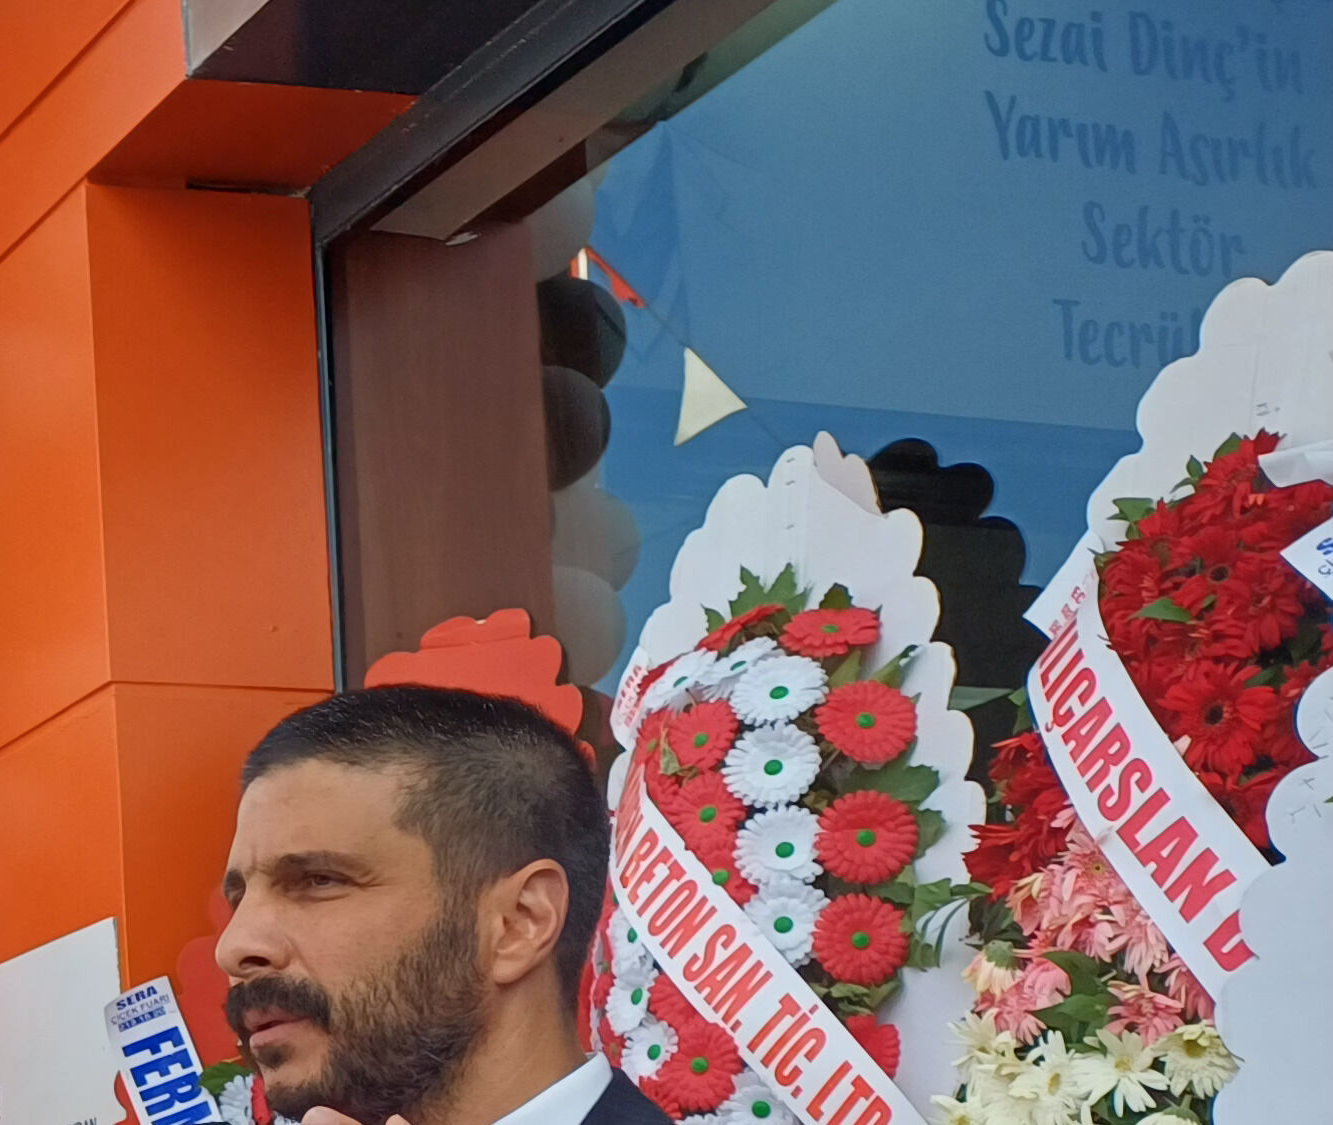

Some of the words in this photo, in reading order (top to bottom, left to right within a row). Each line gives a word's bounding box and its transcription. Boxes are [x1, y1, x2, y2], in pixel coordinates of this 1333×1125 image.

[984, 0, 1109, 73] Sezai
[984, 90, 1137, 175] Yarım
[1082, 200, 1245, 278] Sektör
[116, 985, 158, 1011] SERA
[619, 827, 718, 960] BETON
[683, 923, 774, 1033] SAN.
[747, 992, 827, 1099] TİC.
